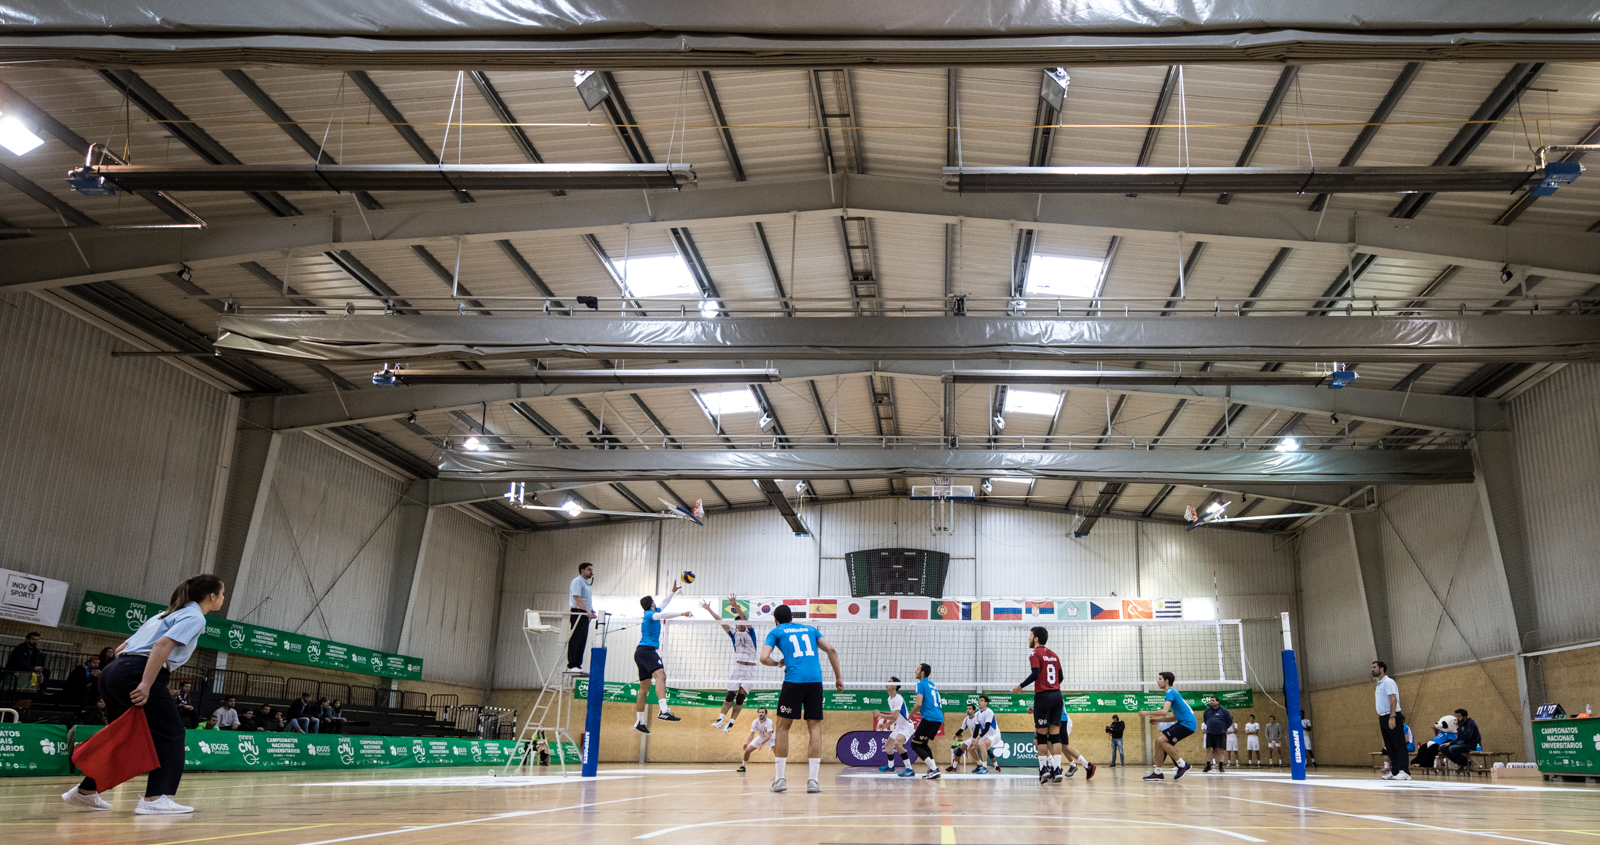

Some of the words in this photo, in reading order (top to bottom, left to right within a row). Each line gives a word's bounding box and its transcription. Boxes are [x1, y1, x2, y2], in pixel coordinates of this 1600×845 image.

[10, 590, 35, 600] SPORTS
[96, 605, 116, 615] JOGOS
[126, 609, 148, 623] CNU
[206, 626, 221, 634] JOGOS
[228, 629, 245, 642] CNU
[307, 645, 321, 656] CNU
[789, 634, 814, 658] 11
[371, 657, 383, 667] CNU
[1047, 664, 1056, 684] 8
[1123, 697, 1138, 706] CNU
[210, 743, 229, 752] JOGOS
[238, 741, 259, 755] CNU
[338, 743, 354, 756] CNU
[413, 745, 425, 756] CNU
